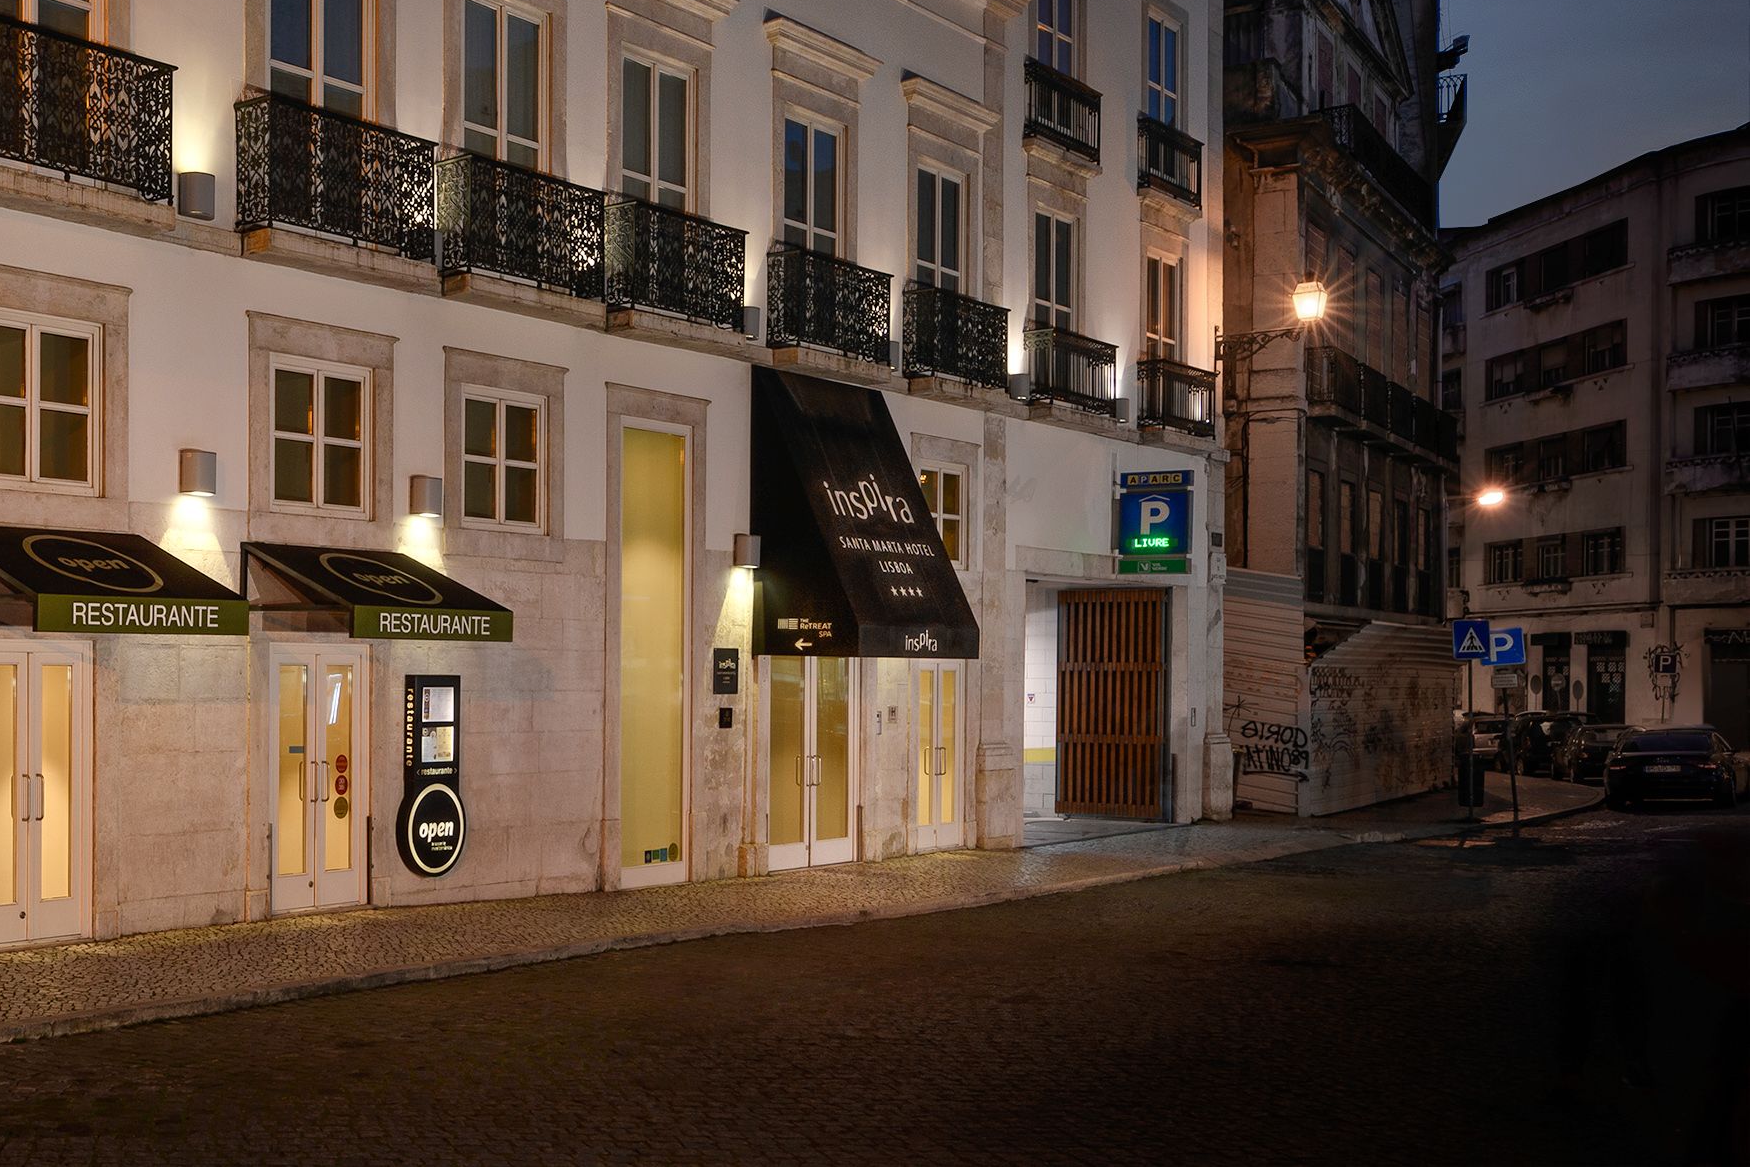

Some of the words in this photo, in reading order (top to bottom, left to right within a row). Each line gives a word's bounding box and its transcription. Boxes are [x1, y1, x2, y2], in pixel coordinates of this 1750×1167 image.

[1129, 474, 1181, 484] APARC
[823, 473, 915, 524] inspira
[1140, 500, 1170, 535] P
[839, 536, 872, 551] SANTA
[871, 539, 904, 554] MARTA
[904, 542, 935, 557] HOTEL
[1134, 537, 1170, 548] LIVRE
[57, 556, 130, 572] open
[878, 560, 914, 575] LISBOA
[352, 572, 411, 586] open
[72, 602, 219, 628] RESTAURANTE
[379, 612, 491, 635] RESTAURANTE
[818, 630, 832, 638] SPA
[905, 629, 938, 652] inspira
[1490, 633, 1513, 662] P
[1659, 656, 1671, 672] P
[406, 688, 414, 767] restaurante
[419, 821, 454, 843] open
